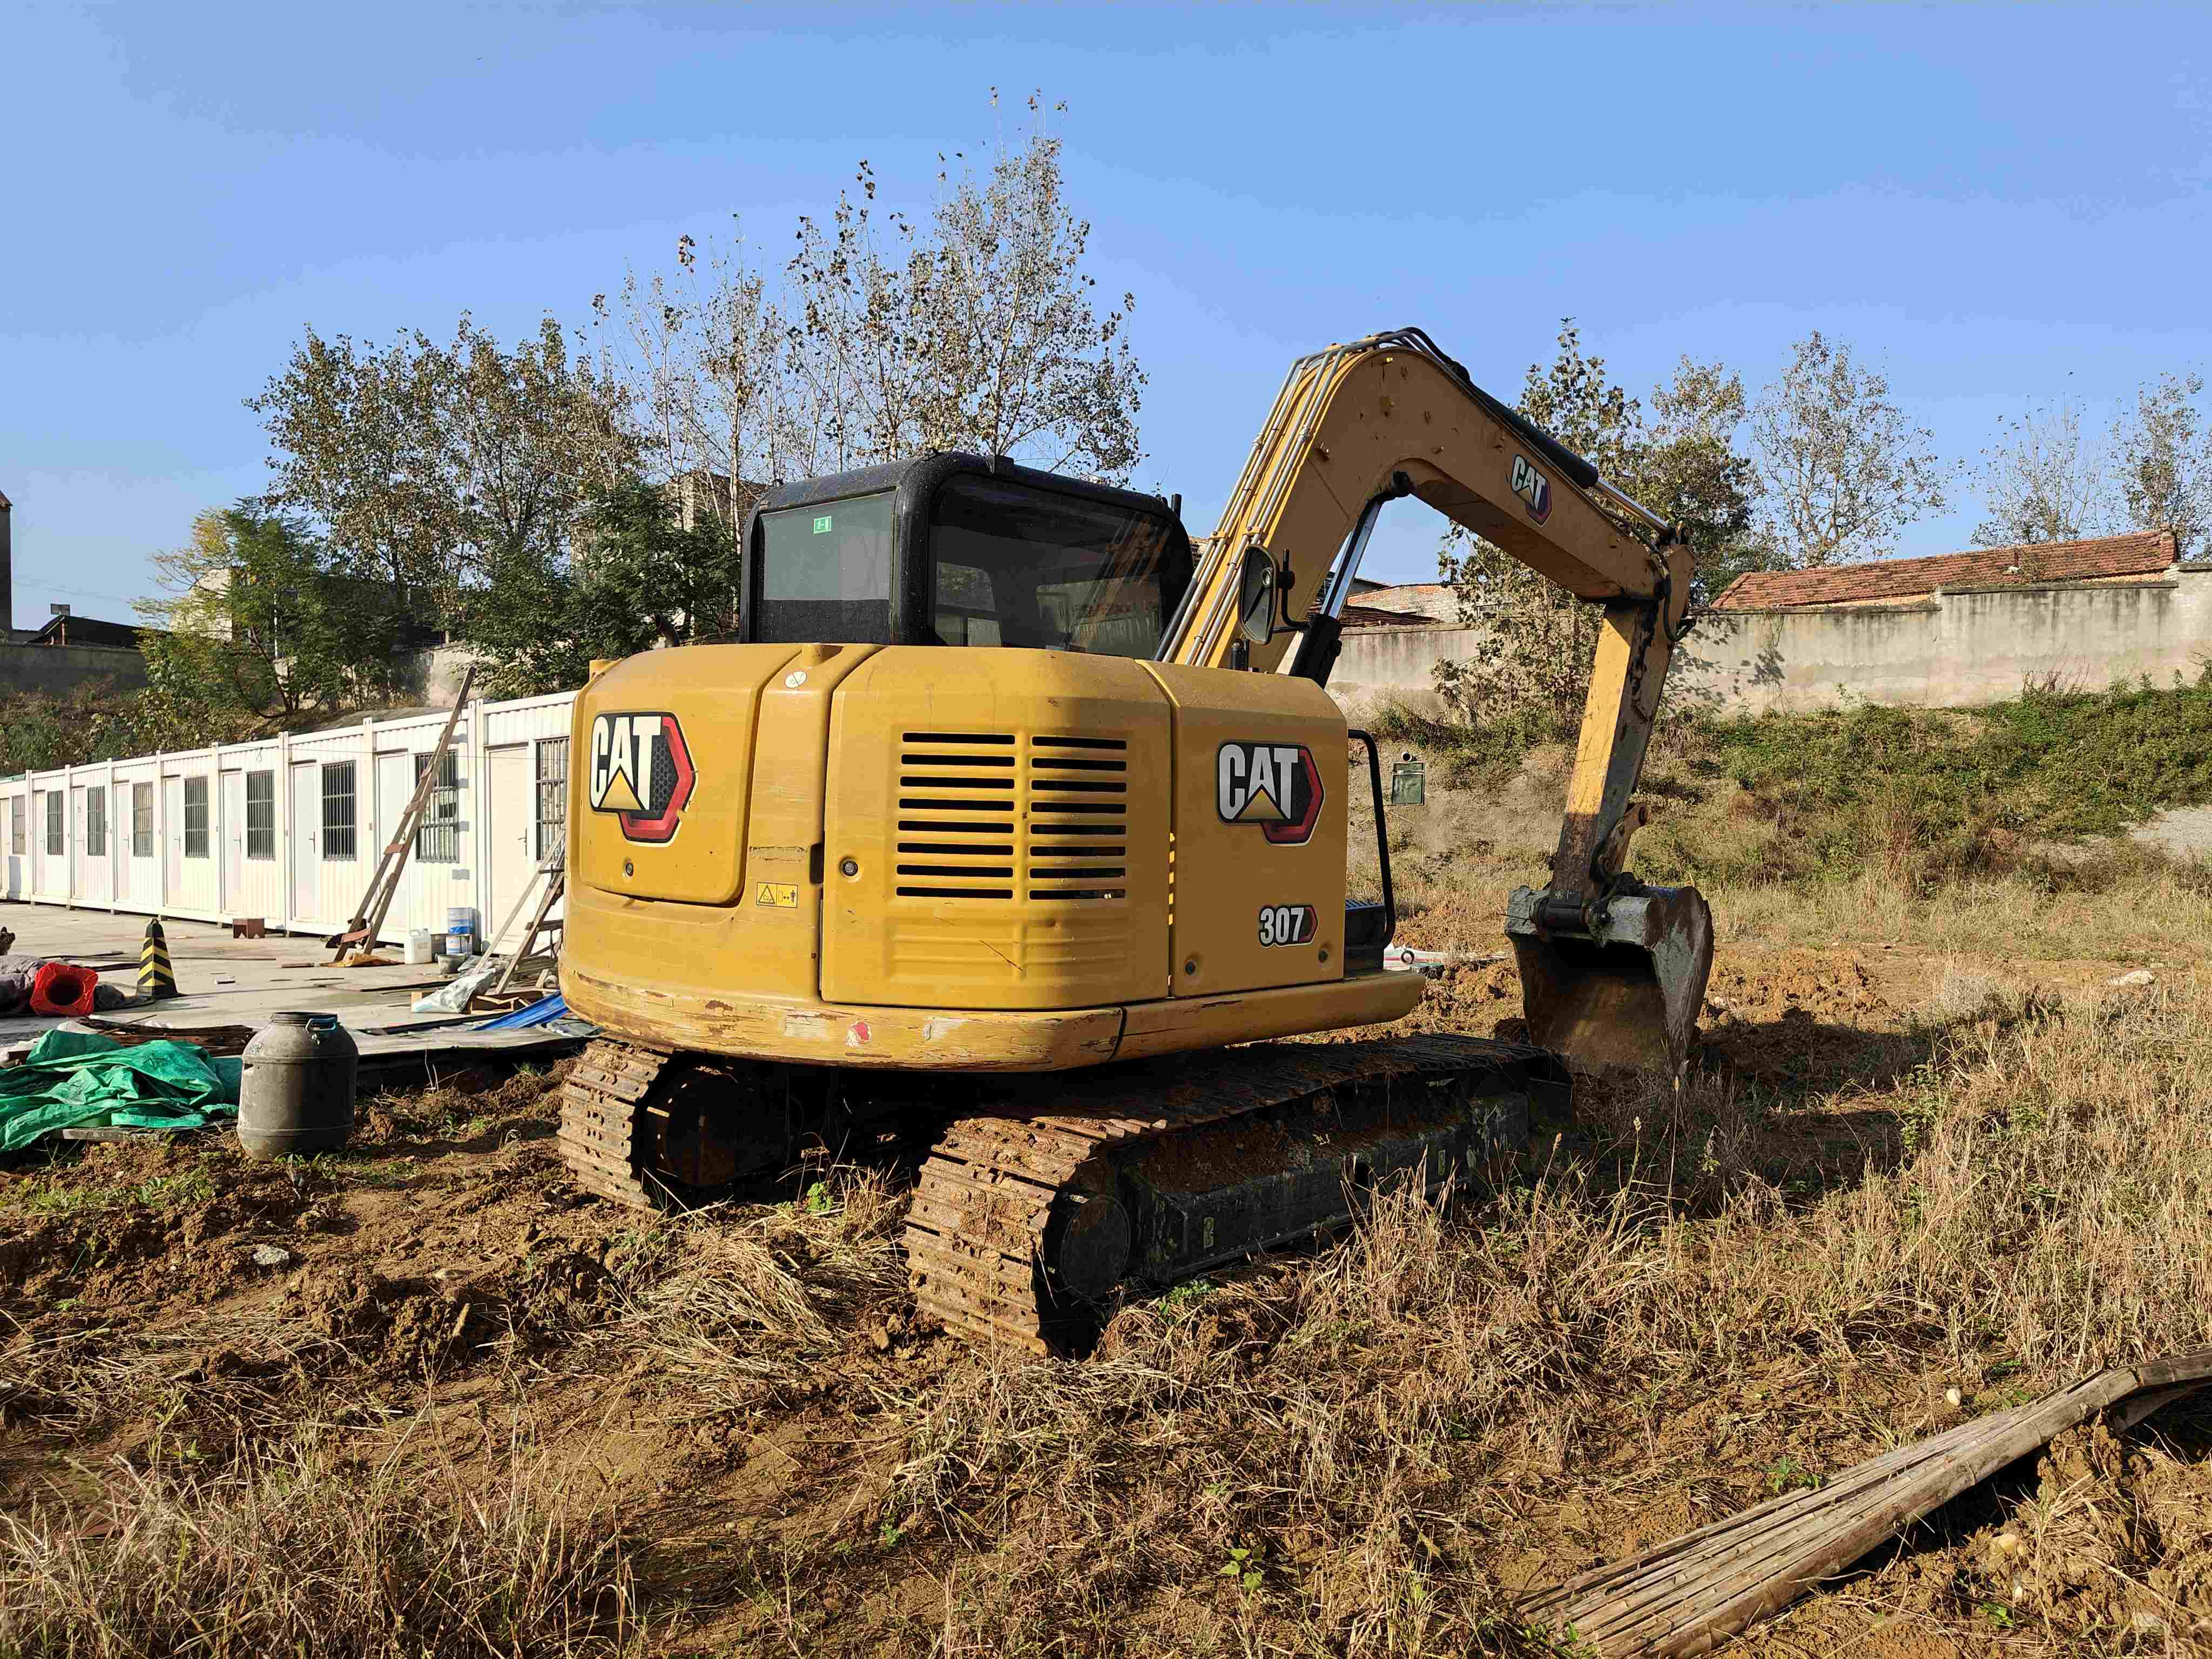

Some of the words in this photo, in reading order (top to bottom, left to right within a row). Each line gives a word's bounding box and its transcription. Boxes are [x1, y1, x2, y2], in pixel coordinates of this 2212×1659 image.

[1512, 456, 1547, 510] CAT
[590, 716, 662, 810] CAT
[1219, 744, 1298, 820] CAT
[1260, 907, 1305, 945] 307
